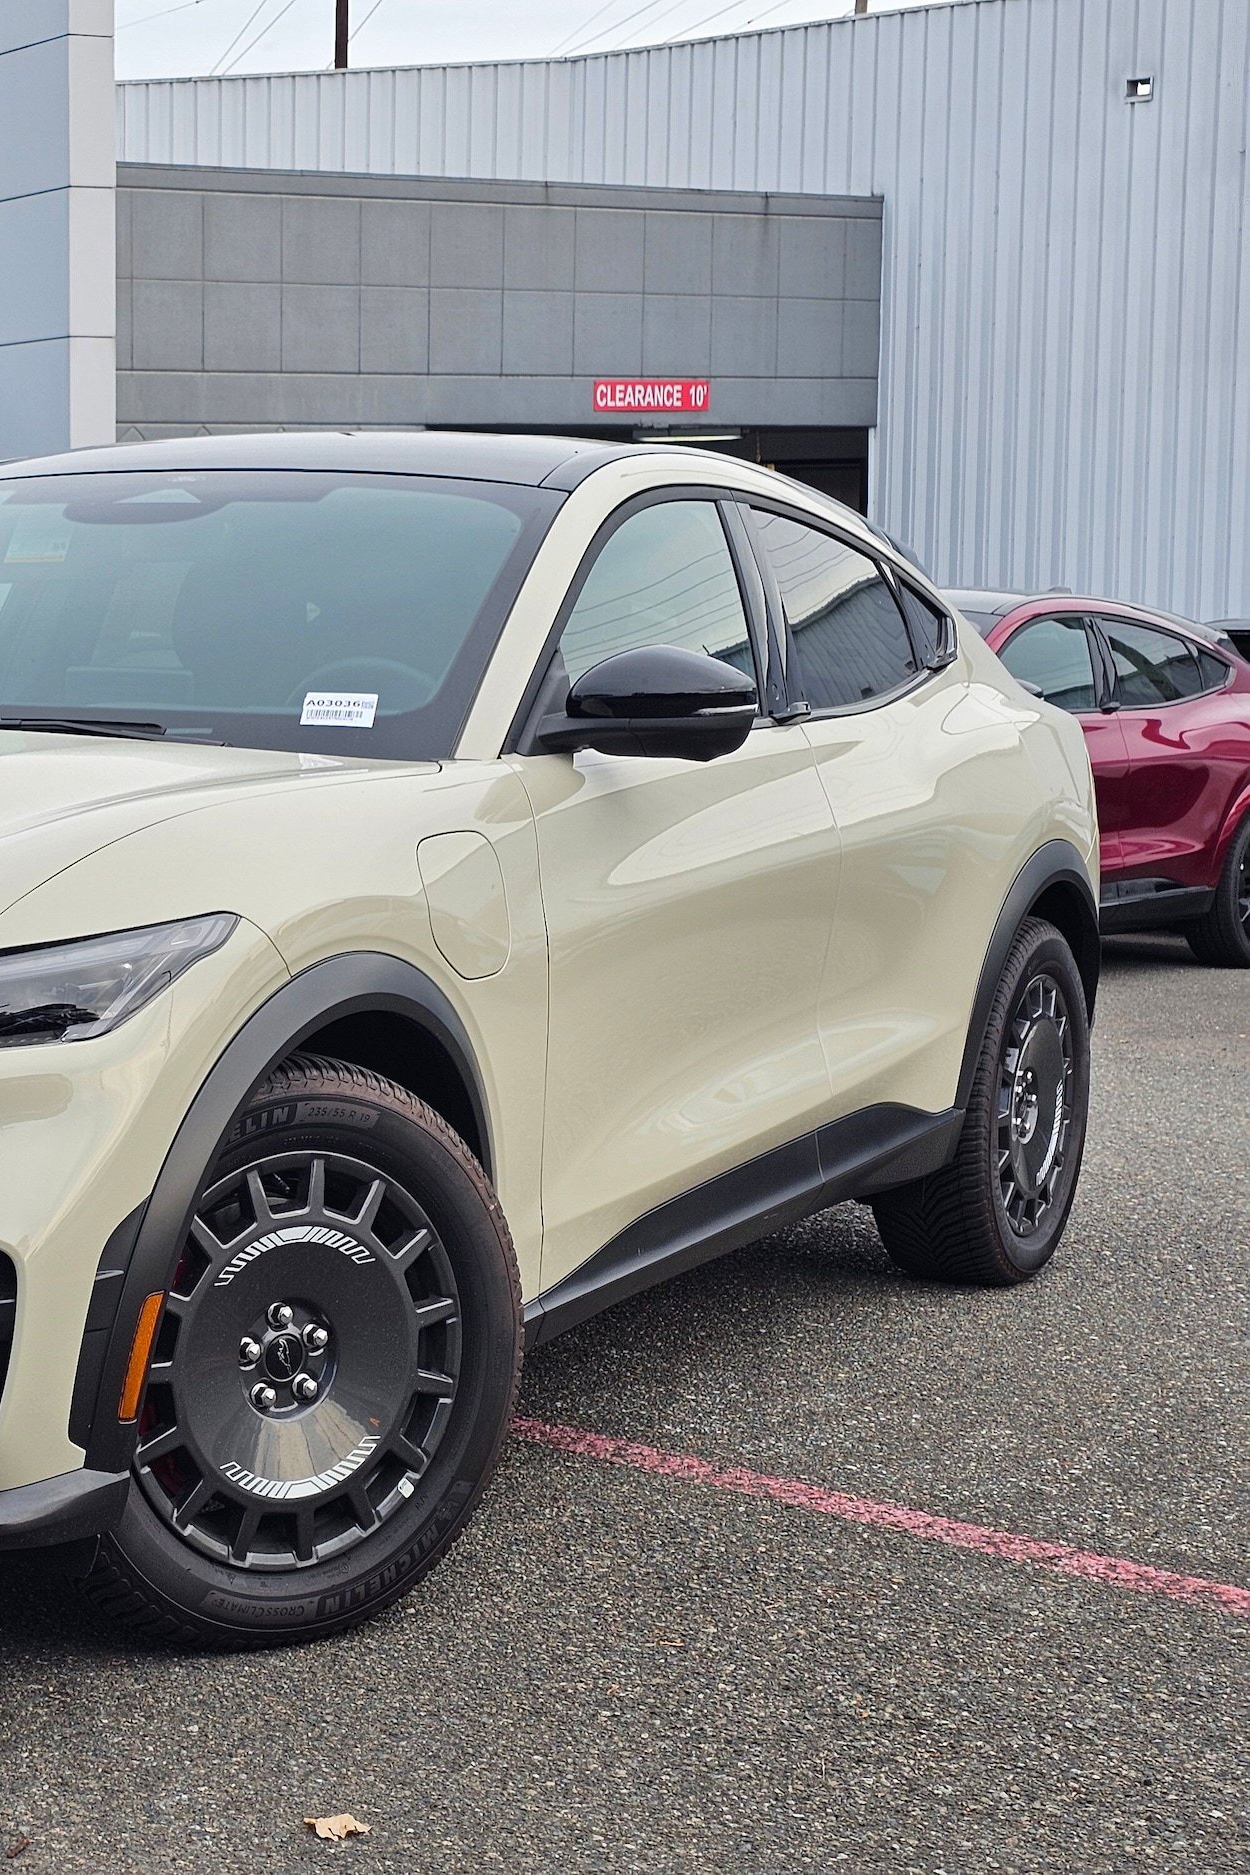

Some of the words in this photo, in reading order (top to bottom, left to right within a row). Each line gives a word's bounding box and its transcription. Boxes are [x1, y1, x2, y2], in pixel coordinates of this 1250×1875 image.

[596, 383, 683, 407] CLEARANCE
[689, 383, 708, 407] 10'
[306, 699, 361, 708] A03036
[229, 1106, 290, 1143] ELIN
[308, 1107, 346, 1118] 235/55
[350, 1109, 356, 1119] R
[359, 1112, 371, 1123] 19
[325, 1523, 440, 1614] MICHELIN
